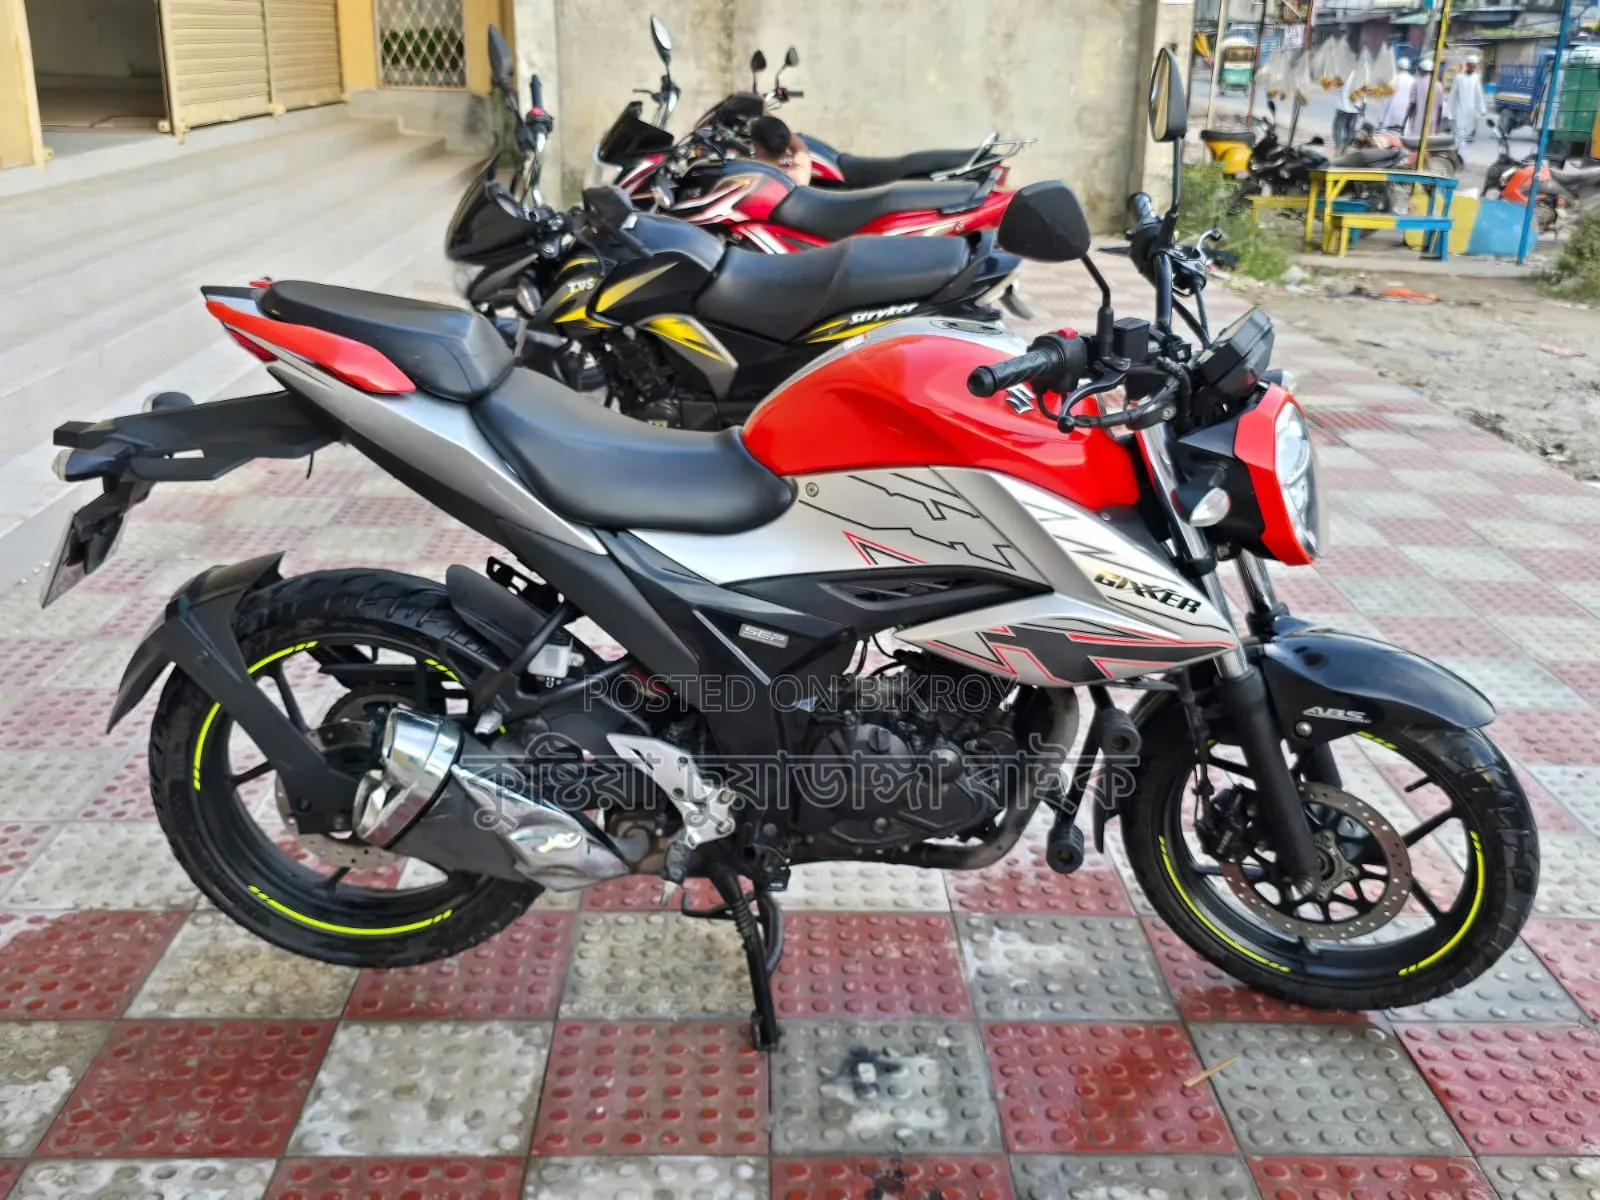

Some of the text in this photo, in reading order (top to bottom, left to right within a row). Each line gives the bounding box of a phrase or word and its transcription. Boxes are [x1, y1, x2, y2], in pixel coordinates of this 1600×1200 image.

[567, 277, 595, 293] TVS
[1094, 571, 1202, 613] GIXXER
[742, 625, 787, 642] SEP
[1302, 706, 1368, 723] ABS
